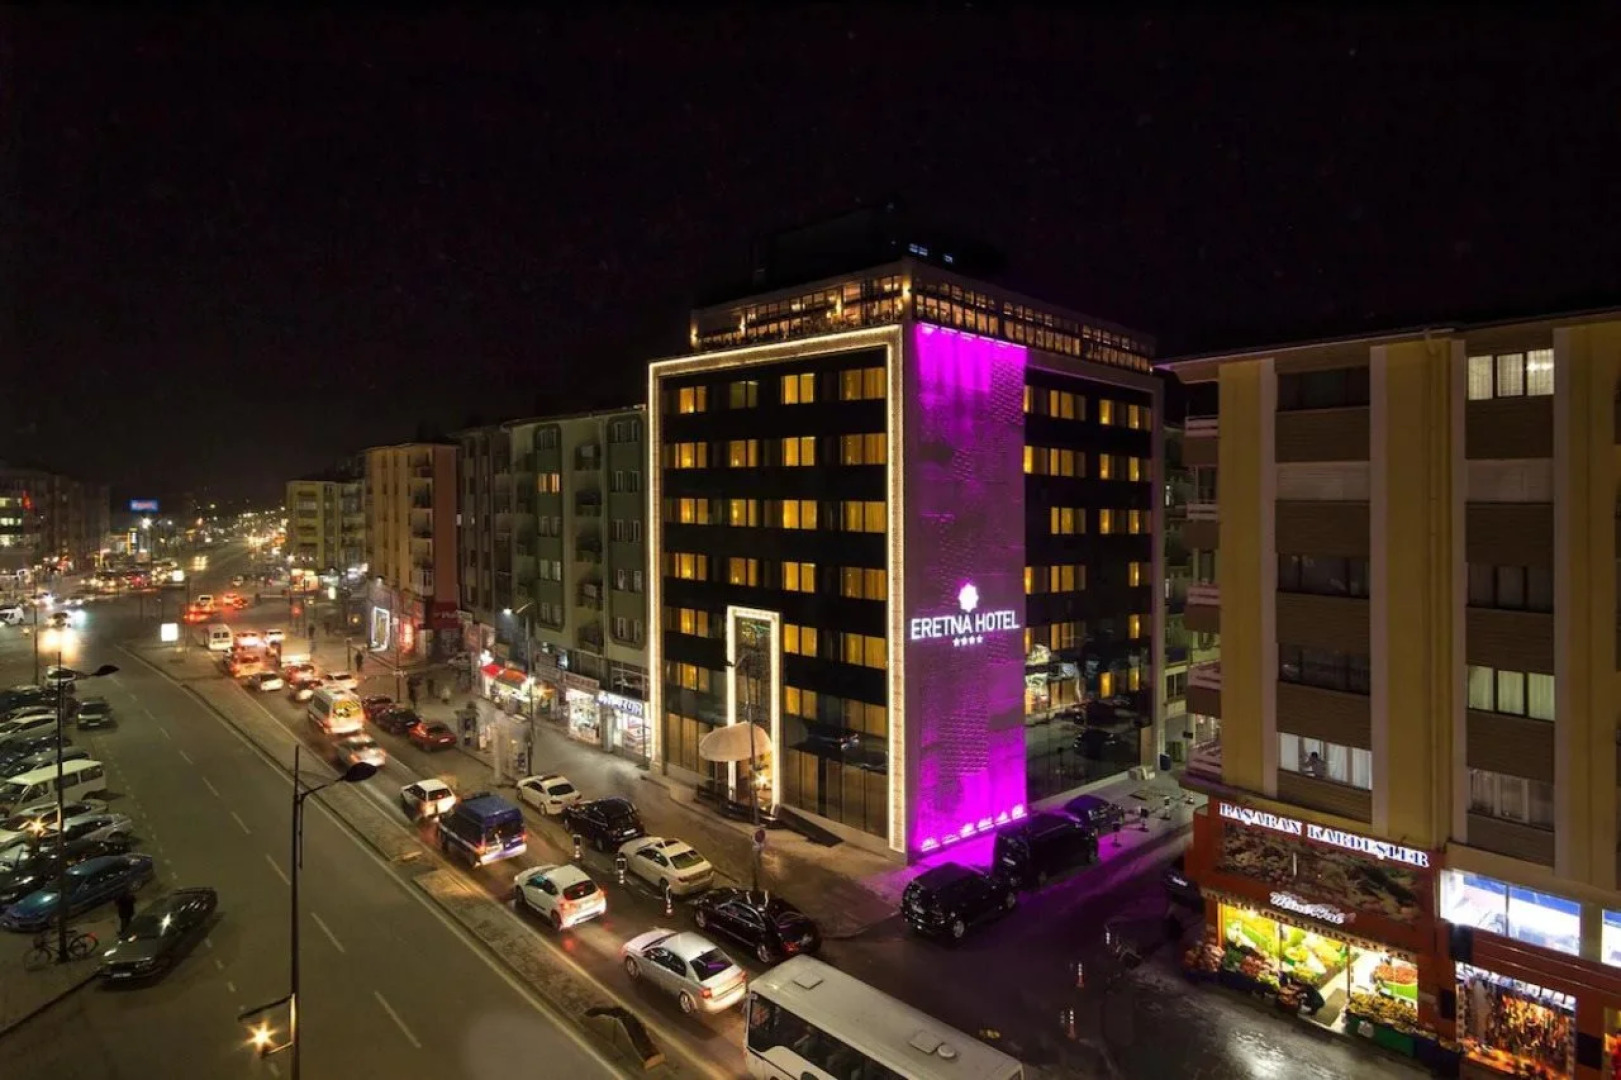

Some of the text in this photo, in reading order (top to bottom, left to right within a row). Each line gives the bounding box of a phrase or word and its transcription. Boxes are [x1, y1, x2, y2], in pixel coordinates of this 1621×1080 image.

[911, 610, 1020, 640] ERETNA HOTEL
[1220, 802, 1430, 868] BAŞARAN KARDEŞLER
